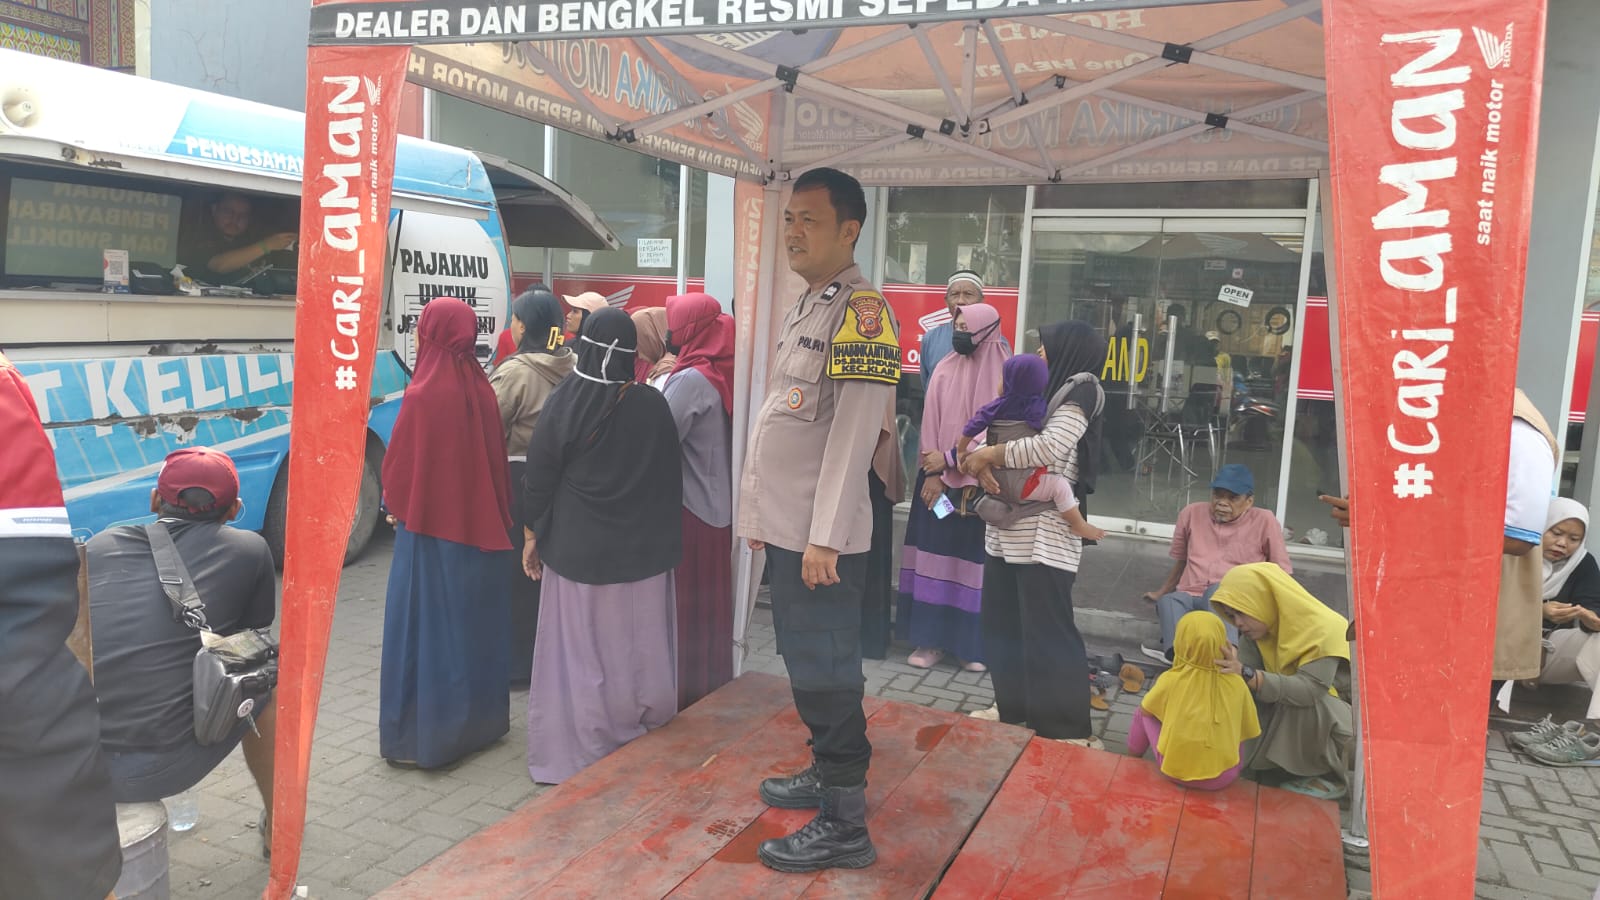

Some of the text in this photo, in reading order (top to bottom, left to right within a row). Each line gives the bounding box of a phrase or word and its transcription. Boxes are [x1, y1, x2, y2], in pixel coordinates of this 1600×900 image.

[335, 9, 450, 38] DEALER
[460, 5, 527, 36] DAN
[538, 0, 704, 33] BENGKEL
[1503, 22, 1514, 68] HONDA
[370, 112, 379, 155] motor
[370, 159, 379, 192] naik
[1477, 79, 1504, 246] saat naik motor
[400, 249, 489, 279] PAJAKMU
[1223, 287, 1250, 299] OPEN
[797, 336, 825, 352] POLRI
